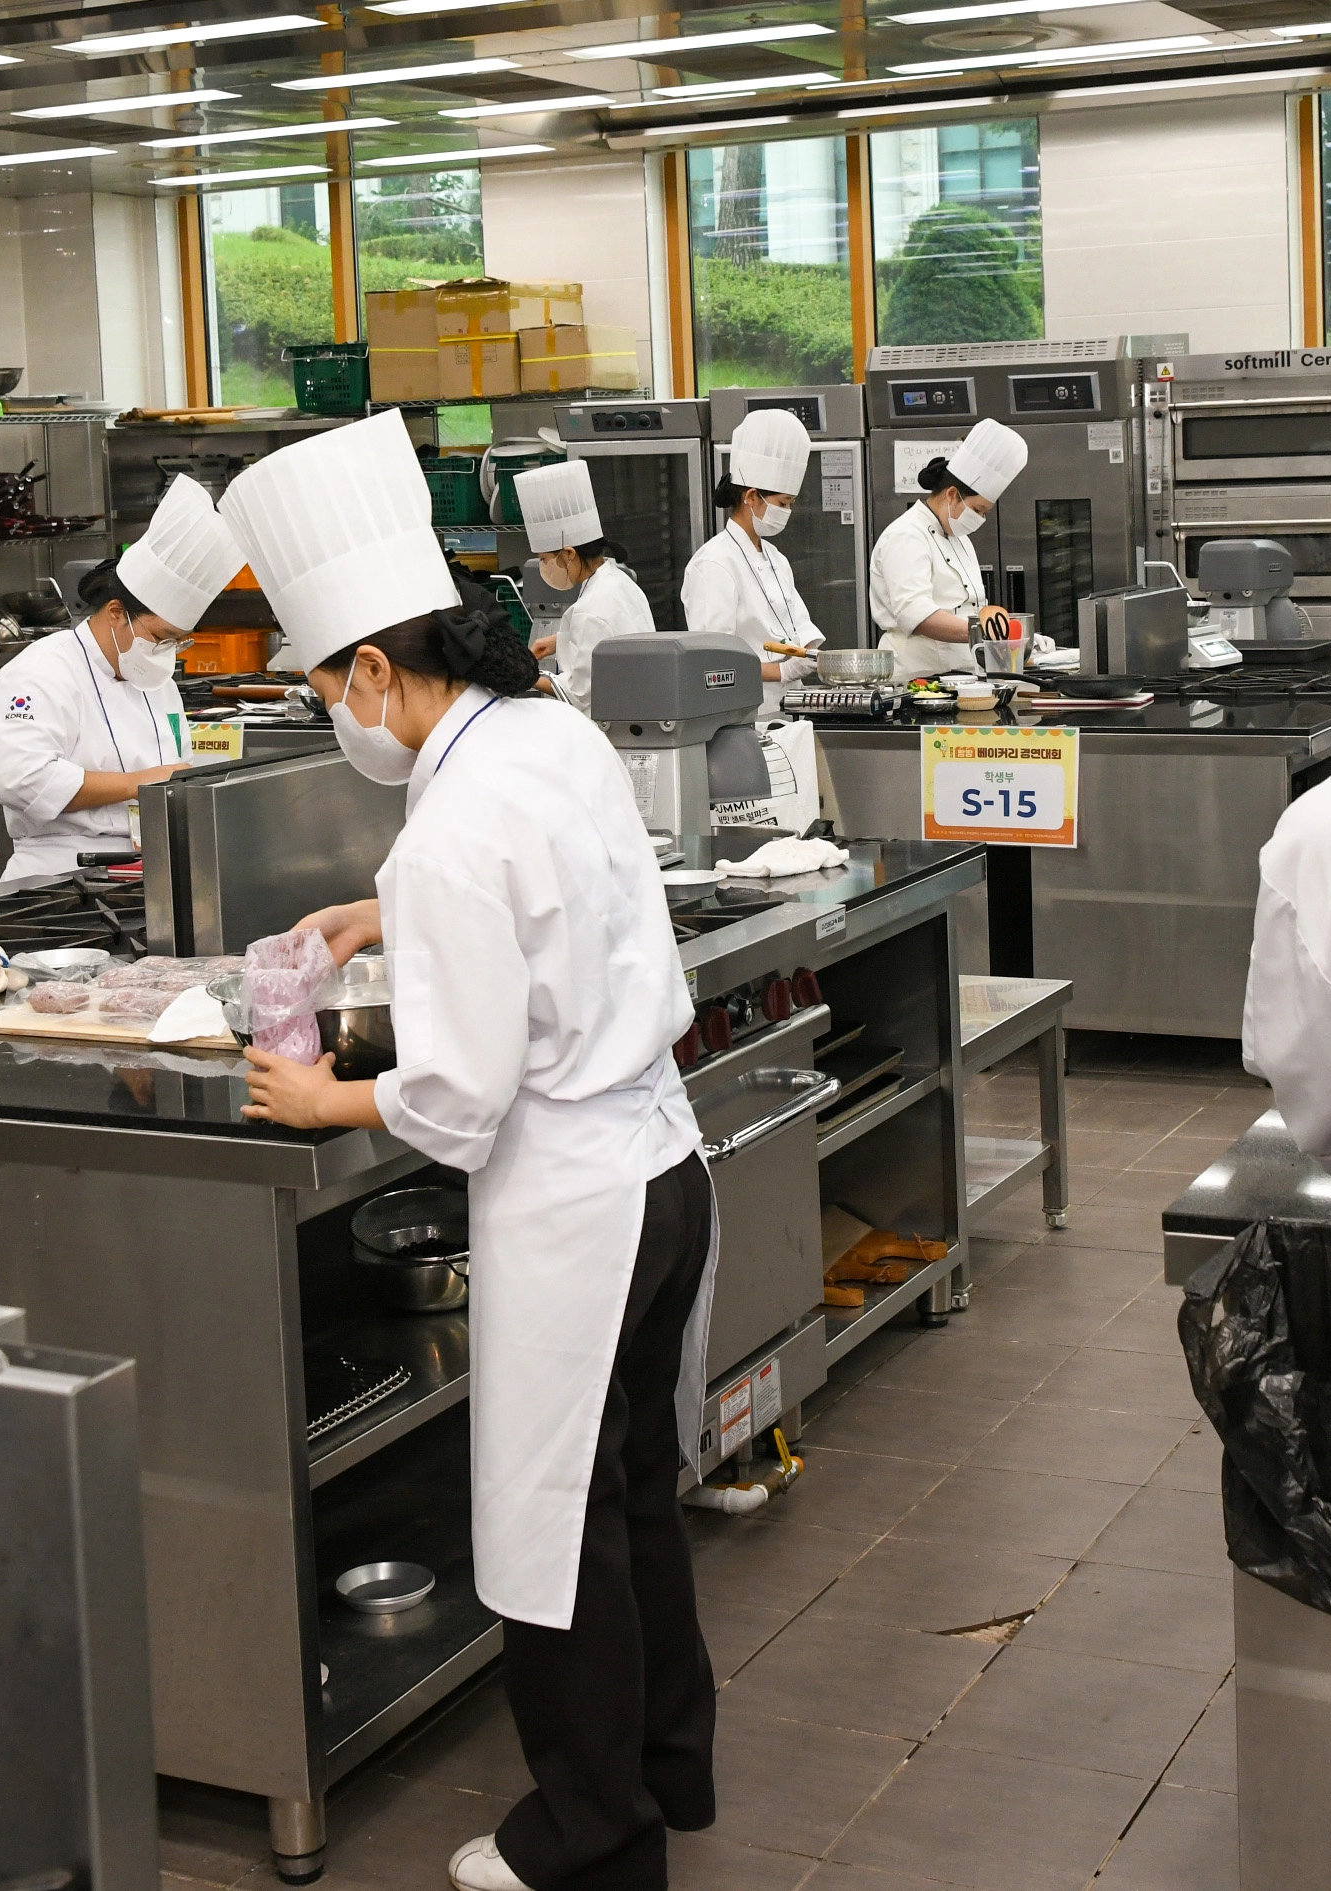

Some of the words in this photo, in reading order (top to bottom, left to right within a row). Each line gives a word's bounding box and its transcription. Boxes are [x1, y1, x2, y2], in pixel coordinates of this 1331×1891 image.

[1224, 351, 1291, 370] softmill
[708, 673, 733, 683] HOBART
[977, 747, 1018, 759] 베이커리
[1020, 748, 1061, 760] 경연대회
[984, 771, 1014, 783] 학생부
[962, 789, 1037, 818] S-15
